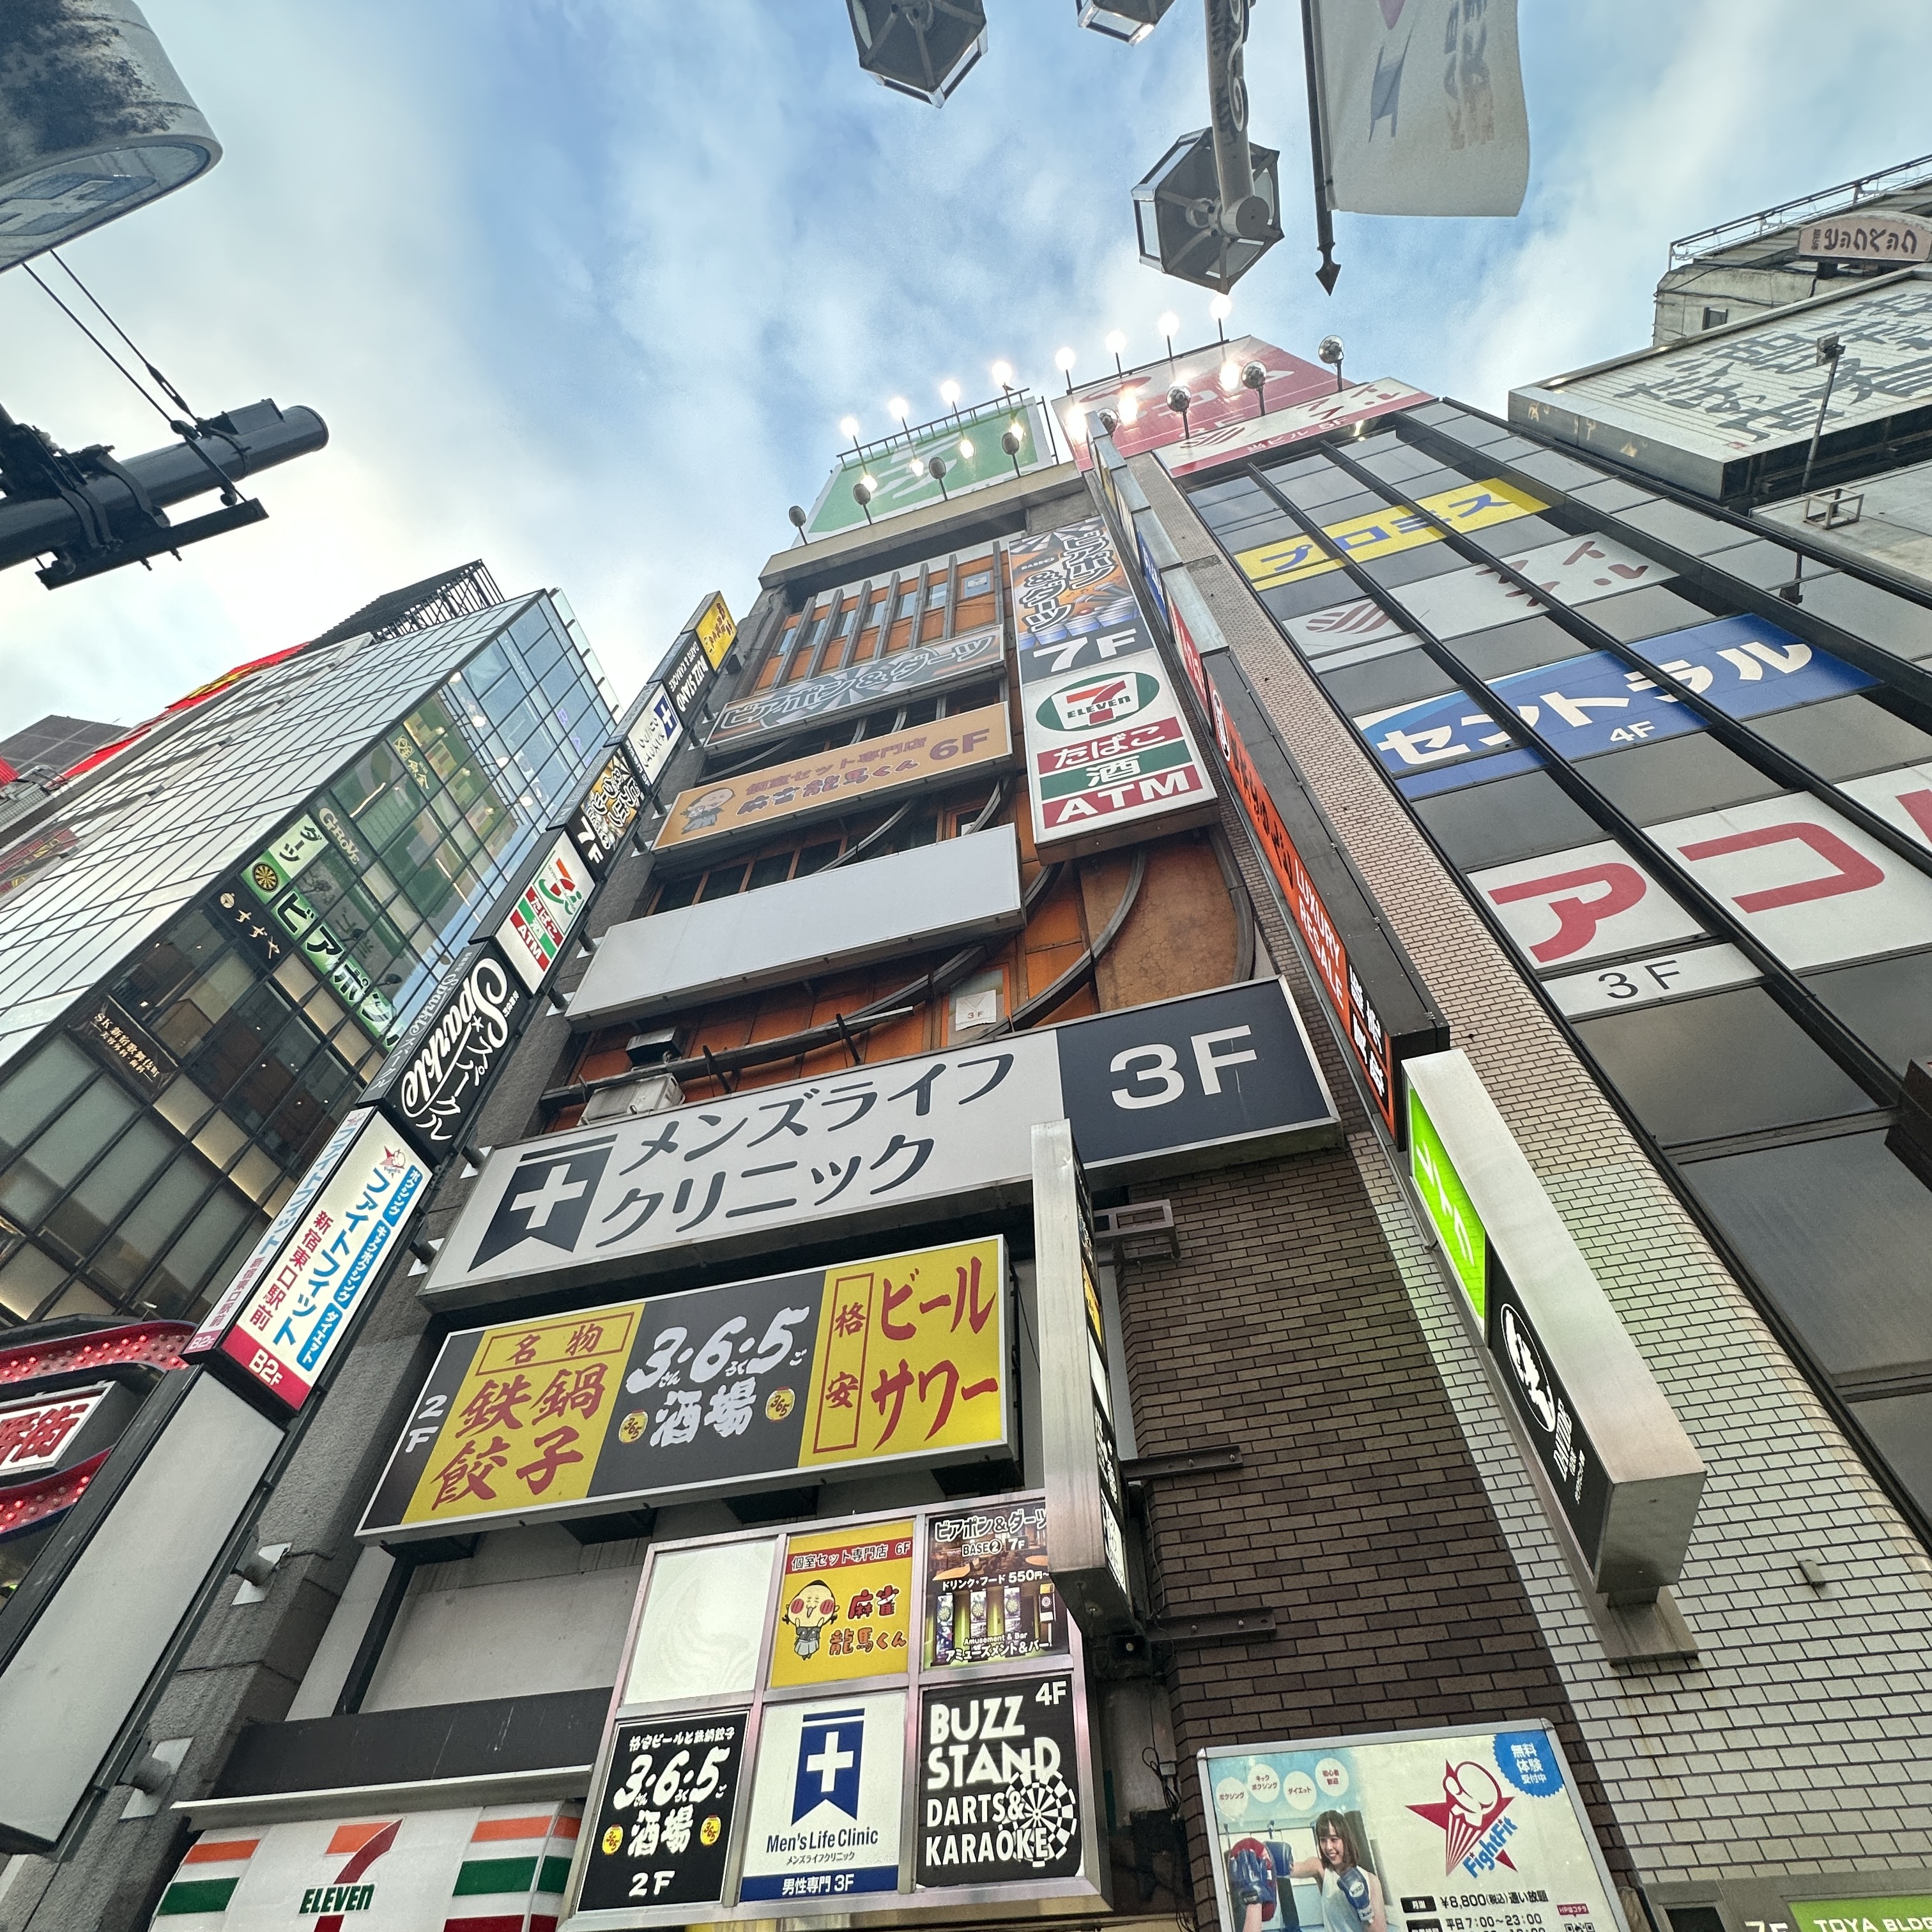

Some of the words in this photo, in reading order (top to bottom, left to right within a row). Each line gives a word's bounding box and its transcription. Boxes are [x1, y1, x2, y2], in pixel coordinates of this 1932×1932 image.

[1319, 417, 1347, 431] 5F
[1261, 489, 1514, 572] プロミス
[1063, 530, 1116, 590] ビアポン
[1033, 628, 1137, 673] 7F
[720, 634, 996, 730] ビアポン&ダーツ
[1376, 640, 1815, 767] セントラル
[929, 728, 990, 761] 6F
[1054, 725, 1166, 770] たばこ
[1609, 721, 1659, 744] 4F
[1087, 755, 1140, 788] 酒
[1056, 768, 1190, 824] ATM
[279, 824, 323, 863] ダーツ
[319, 807, 361, 866] GROVE
[577, 815, 604, 864] 7F
[1489, 788, 1932, 963] アコ
[530, 896, 560, 939] たばこ
[1294, 858, 1342, 970] LUXURY
[518, 925, 543, 960] ATM
[1298, 895, 1346, 1011] RESALE
[1598, 959, 1682, 1000] 3F
[401, 958, 509, 1117] Sparkle
[967, 1011, 984, 1019] 3F
[415, 1036, 494, 1141] スパークル
[1110, 1025, 1259, 1110] 3F
[619, 1052, 1015, 1176] メンズライフ
[259, 1127, 356, 1255] ファイトフィット
[388, 1168, 421, 1216] ボクシング
[595, 1133, 935, 1248] クリニック
[249, 1210, 334, 1331] 新宿東口駅前
[273, 1167, 391, 1346] ファイトフィット
[881, 1256, 997, 1342] ビール
[188, 1333, 216, 1351] B2F
[303, 1309, 340, 1364] ダイエット
[505, 1322, 604, 1364] 名物
[825, 1302, 868, 1409] 格安
[249, 1350, 283, 1386] B2F
[455, 1362, 609, 1439] 鉄鍋
[650, 1376, 757, 1448] 酒場
[871, 1358, 999, 1452] サワー
[404, 1393, 446, 1455] 2F
[431, 1425, 585, 1512] 餃子
[792, 1543, 889, 1572] 個室セット専門店
[895, 1540, 911, 1555] 6F
[1008, 1538, 1025, 1551] 7F
[847, 1584, 900, 1620] 麻雀
[942, 1574, 1006, 1591] ドリンク・フード
[829, 1626, 908, 1658] 龍馬くん
[963, 1634, 1005, 1646] Amusement
[1007, 1633, 1014, 1641] &
[1015, 1631, 1028, 1640] Bar
[930, 1695, 1024, 1745] BUZZ
[1035, 1680, 1068, 1706] 4F
[927, 1738, 1061, 1790] STAND
[1510, 1742, 1537, 1758] 無料
[1516, 1758, 1544, 1774] 体験
[1219, 1791, 1245, 1801] ボクシング
[1288, 1786, 1312, 1795] ダイエット
[1521, 1772, 1547, 1784] 受付中
[627, 1804, 694, 1857] 酒場
[767, 1832, 808, 1854] Men's
[809, 1831, 836, 1850] Life
[838, 1827, 878, 1848] Clinic
[925, 1825, 1049, 1867] KARAOKE
[1462, 1815, 1518, 1880] FightFit
[785, 1850, 855, 1866] メンズライフクリニック
[629, 1871, 675, 1897] 2F
[781, 1874, 831, 1896] 男性専門
[834, 1873, 855, 1893] 3F
[1813, 1918, 1876, 1932] TOYA
